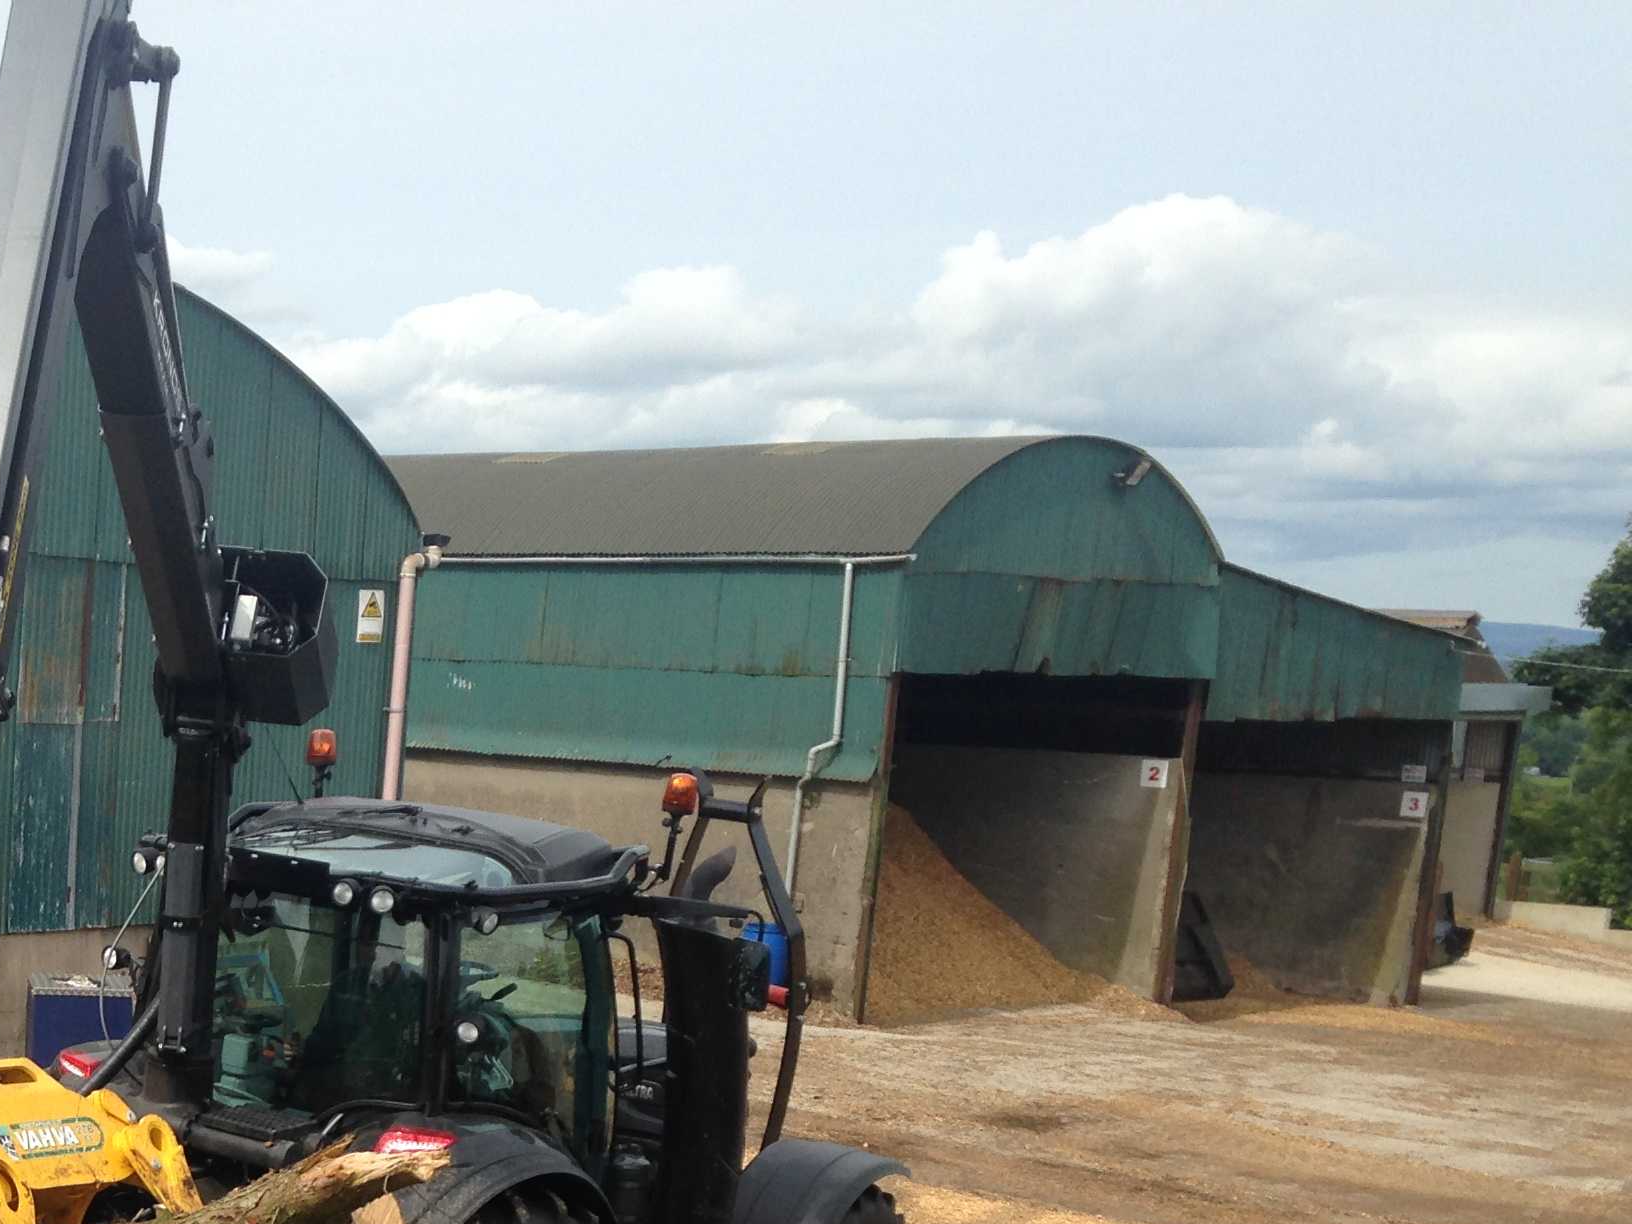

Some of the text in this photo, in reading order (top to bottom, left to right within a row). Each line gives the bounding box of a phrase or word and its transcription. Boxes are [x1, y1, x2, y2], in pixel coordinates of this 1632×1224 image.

[1148, 766, 1160, 781] 2
[1408, 797, 1420, 812] 3
[13, 1125, 80, 1150] VAHVA
